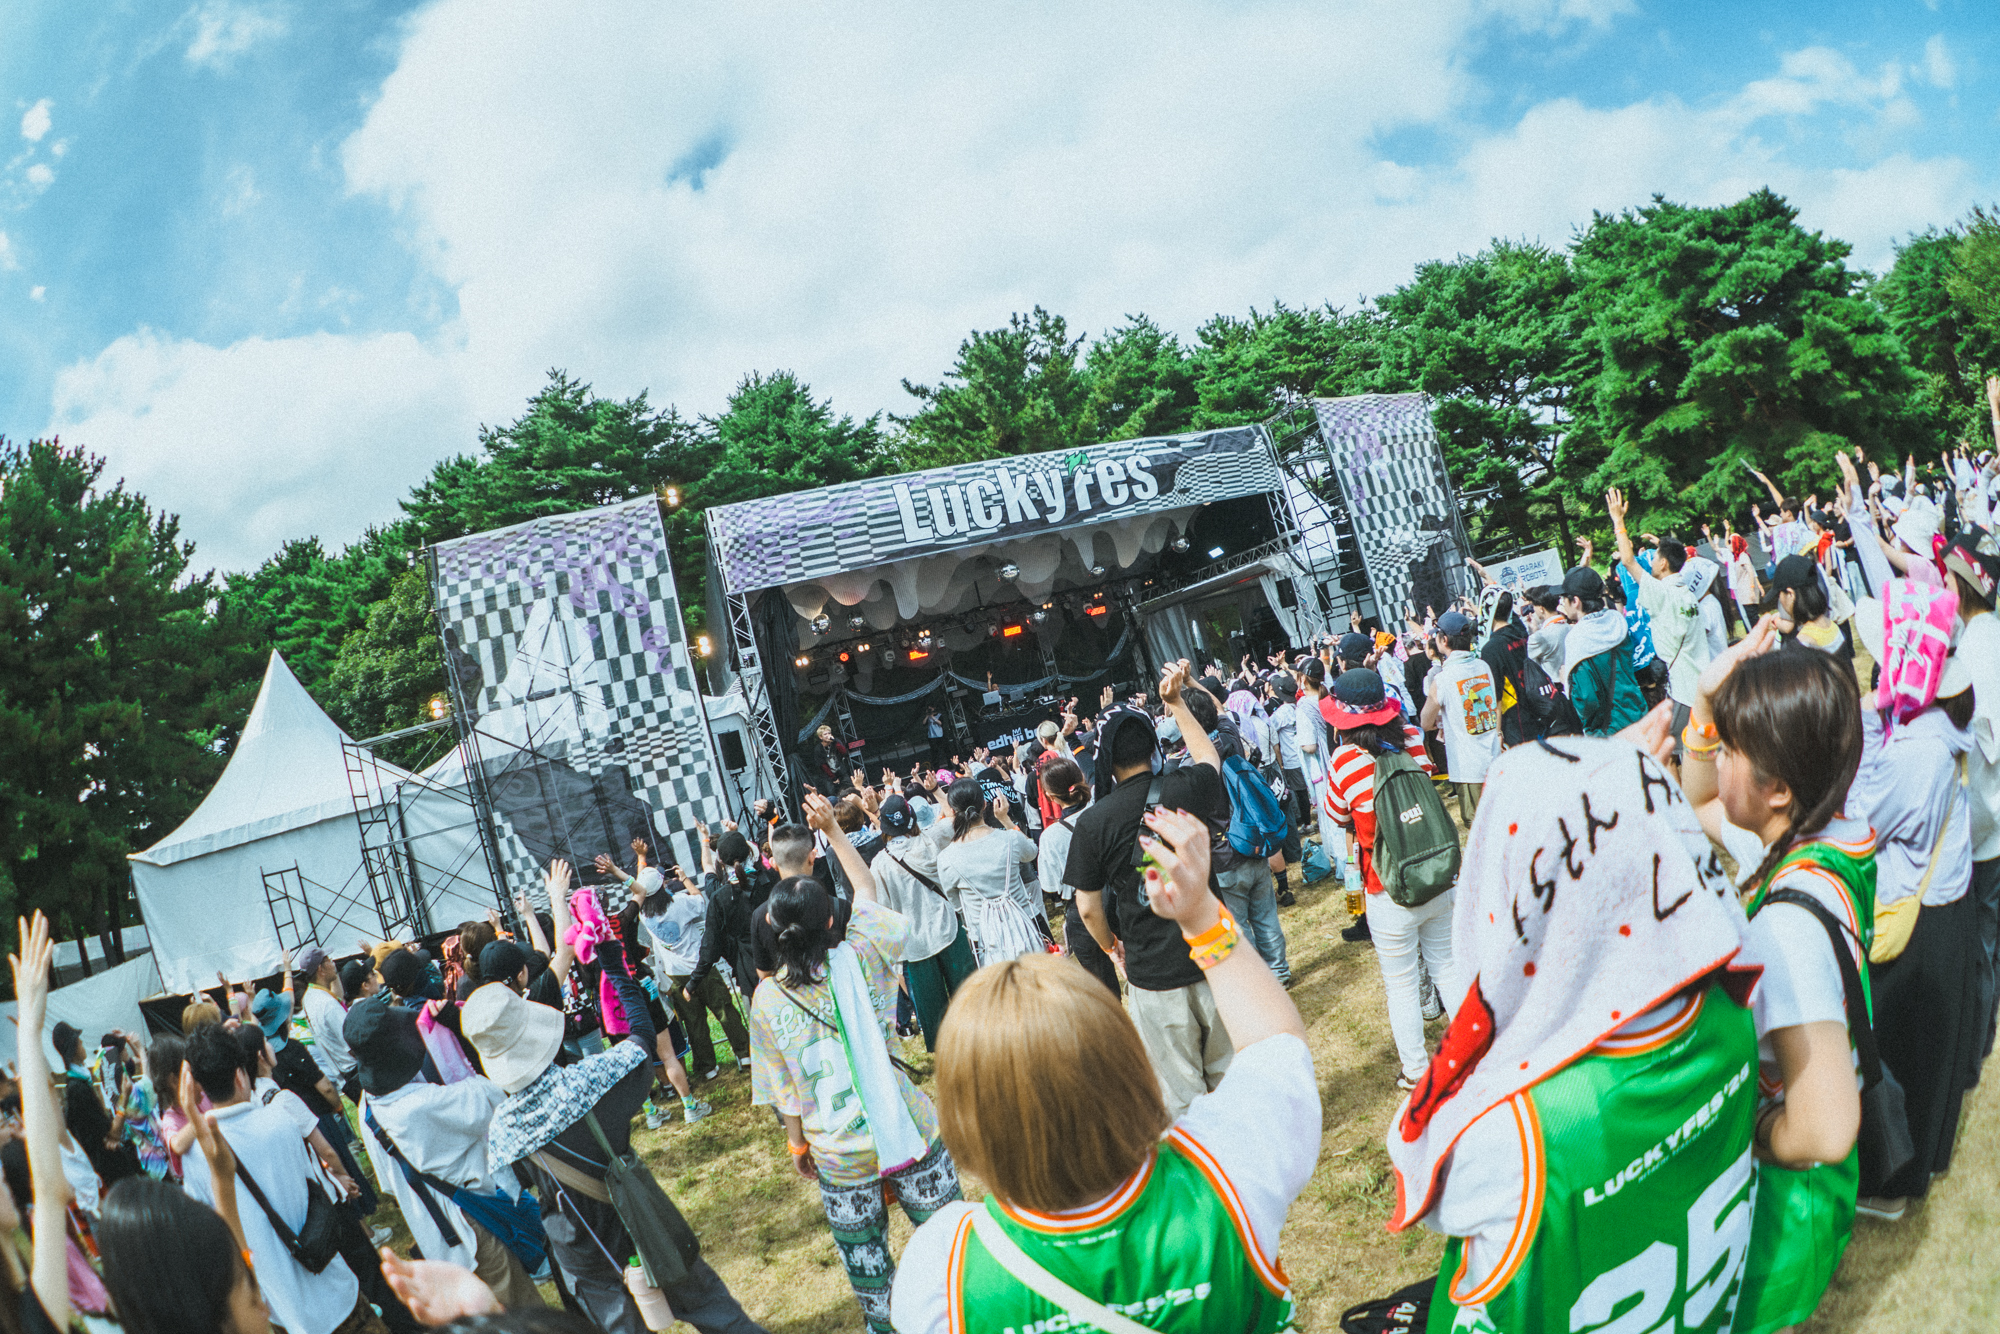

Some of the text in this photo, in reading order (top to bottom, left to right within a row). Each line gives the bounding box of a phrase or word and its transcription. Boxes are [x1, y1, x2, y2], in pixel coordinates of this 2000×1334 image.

[1517, 560, 1545, 574] IBARAKI
[1521, 569, 1548, 582] ROBOTS
[1400, 803, 1424, 823] oui
